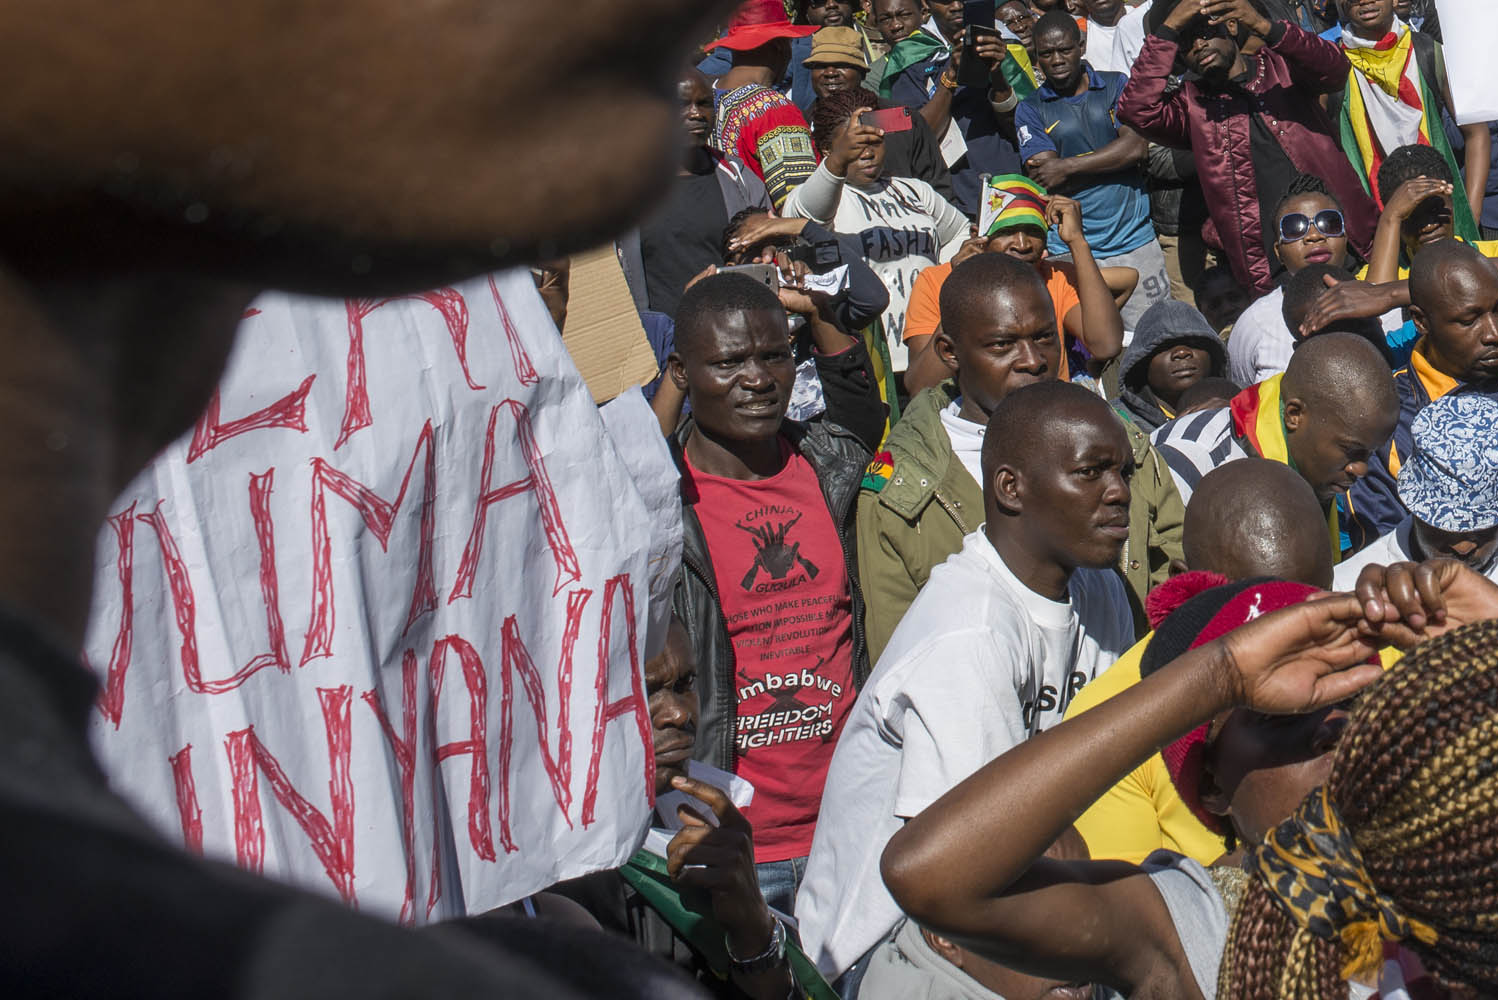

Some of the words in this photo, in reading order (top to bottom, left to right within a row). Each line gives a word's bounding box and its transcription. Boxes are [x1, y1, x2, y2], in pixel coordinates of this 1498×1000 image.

[750, 604, 773, 617] WHO
[775, 599, 799, 611] MAKE
[774, 611, 824, 628] IMPOSSIBLE
[760, 644, 810, 661] INEVITABLE
[738, 669, 841, 704] mbabwe
